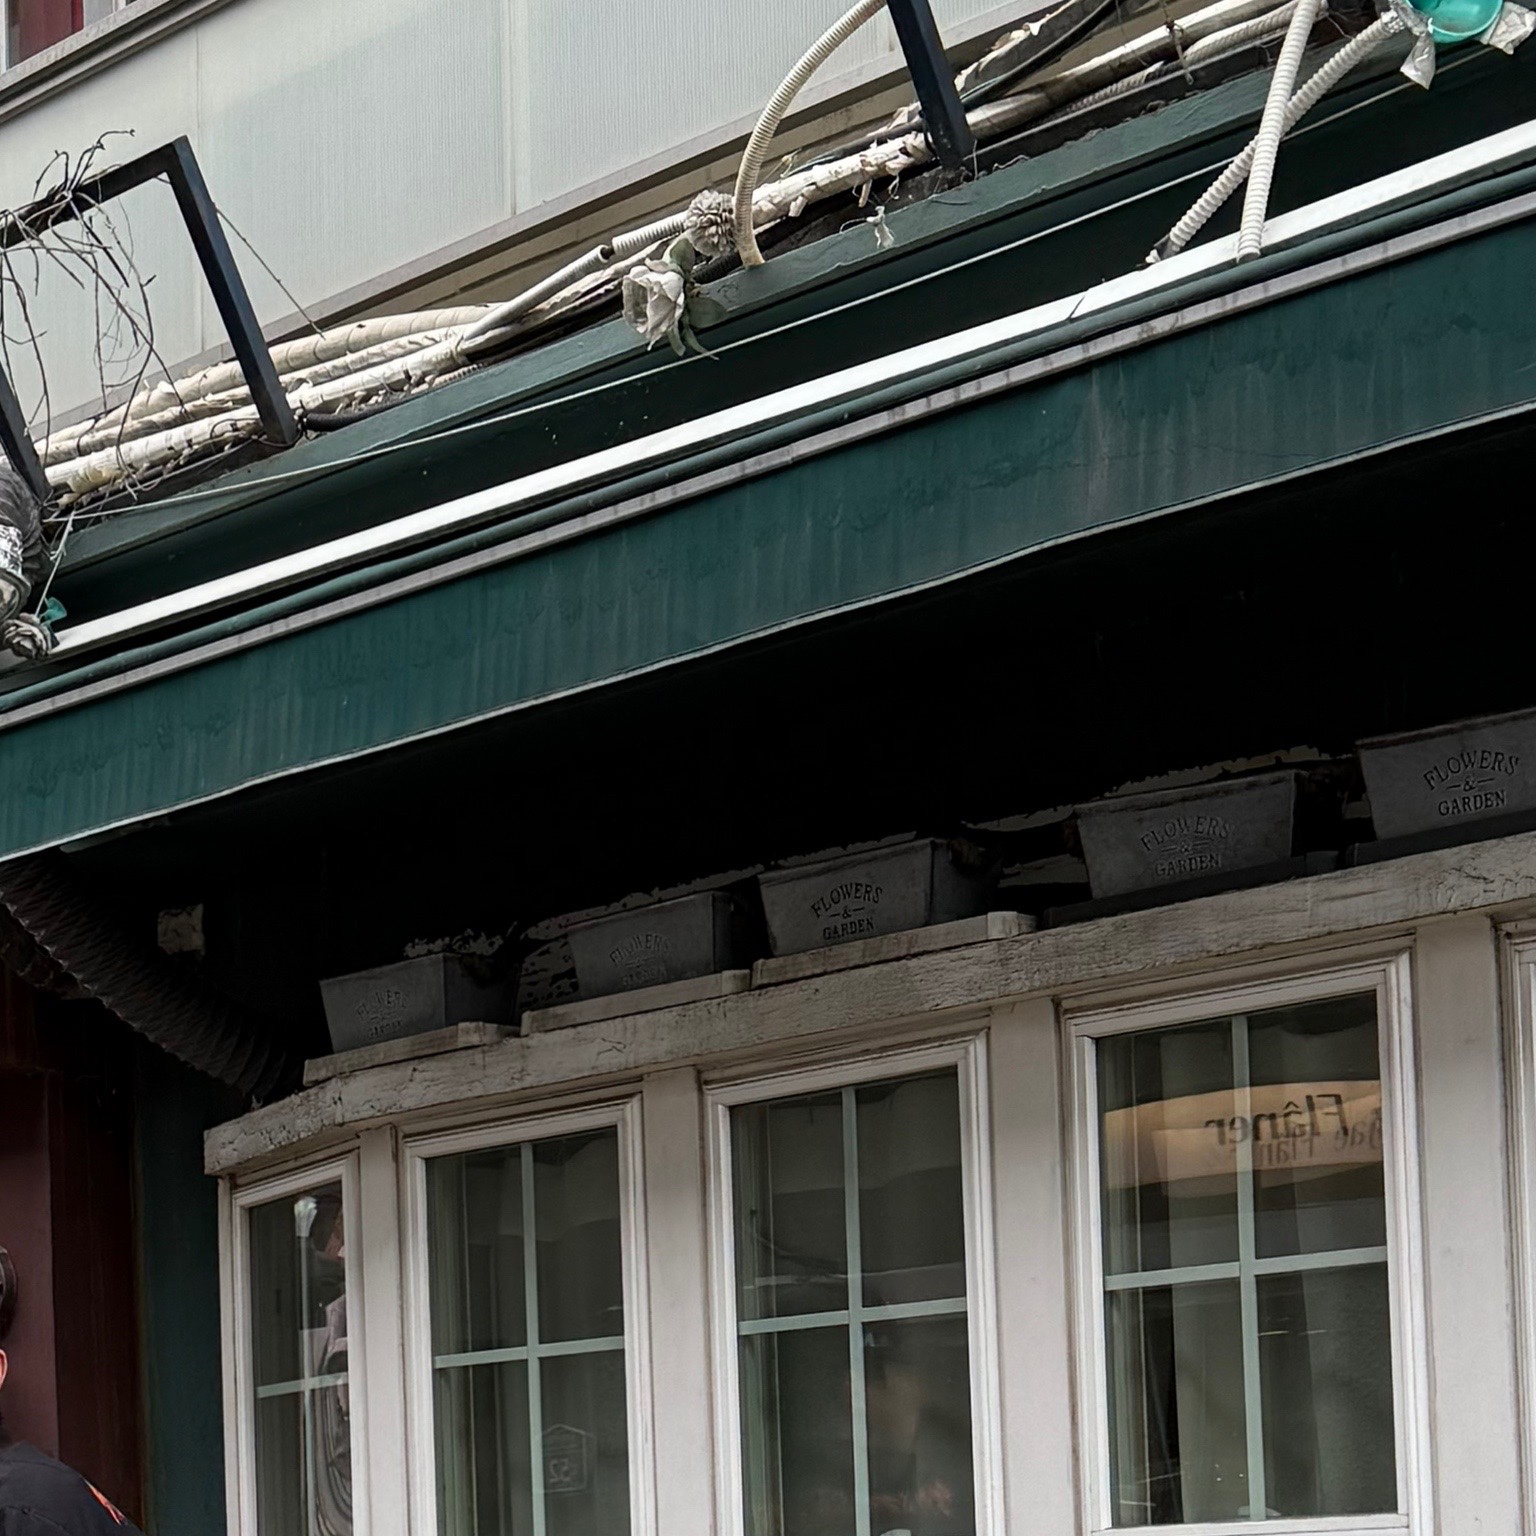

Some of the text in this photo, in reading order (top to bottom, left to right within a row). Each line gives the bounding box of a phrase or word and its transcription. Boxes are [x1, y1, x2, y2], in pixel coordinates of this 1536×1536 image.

[1422, 749, 1519, 791] FLOWERS
[1437, 789, 1507, 817] GARDEN
[1140, 816, 1232, 852] FLOWERS
[1153, 852, 1223, 879] GARDEN
[810, 882, 884, 918] FLOWERS
[822, 917, 875, 941] GARDEN
